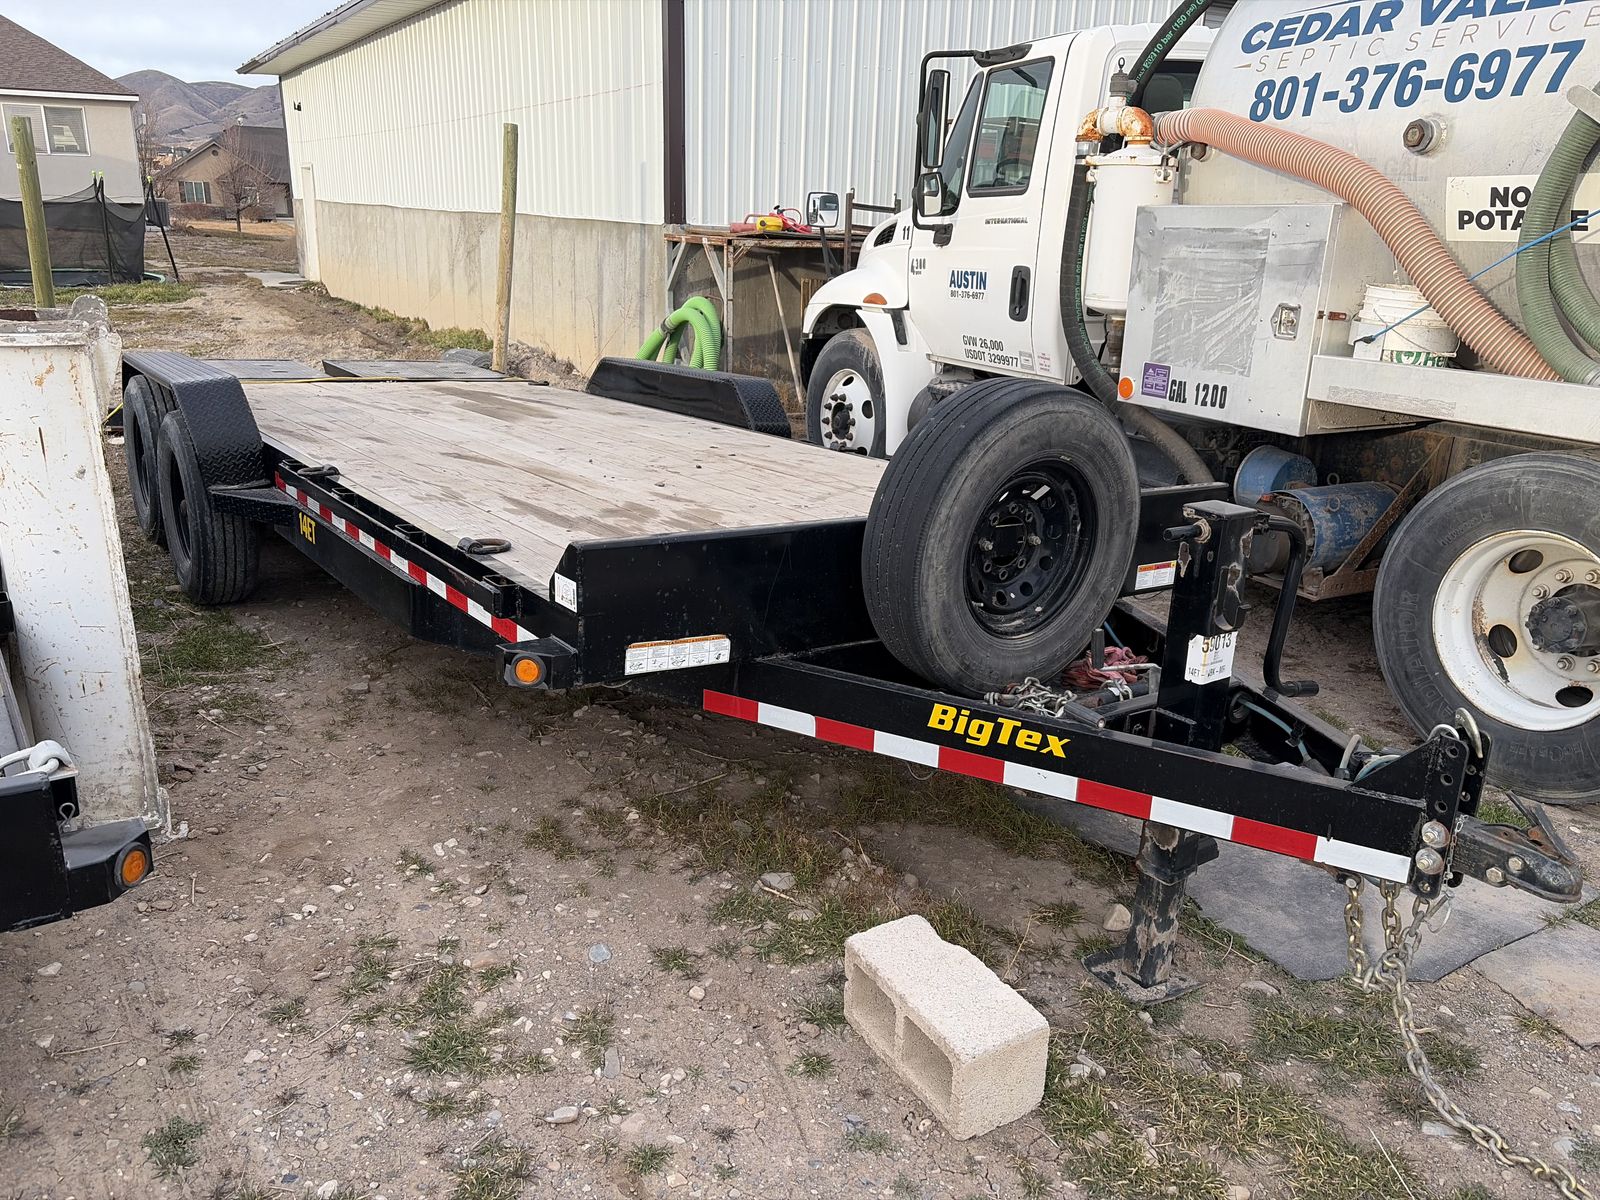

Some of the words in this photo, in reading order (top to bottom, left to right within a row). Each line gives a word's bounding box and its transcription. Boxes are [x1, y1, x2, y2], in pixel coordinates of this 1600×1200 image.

[1161, 30, 1174, 45] bar
[1172, 14, 1187, 31] (150
[1241, 0, 1403, 54] CEDAR
[1255, 37, 1385, 73] SEPTIC
[1249, 39, 1586, 123] 801-376-6977
[1490, 186, 1532, 208] NO
[1458, 210, 1589, 231] POTAE
[903, 225, 910, 240] 11
[949, 270, 987, 290] AUSTIN
[950, 290, 985, 300] 801-376-6977
[962, 334, 978, 347] GVW
[979, 338, 1004, 351] 26,000
[964, 348, 987, 363] USDOT
[988, 353, 1019, 368] 3299977
[1169, 379, 1187, 403] GAL
[1194, 382, 1228, 409] 1200
[927, 703, 1071, 758] BigTex
